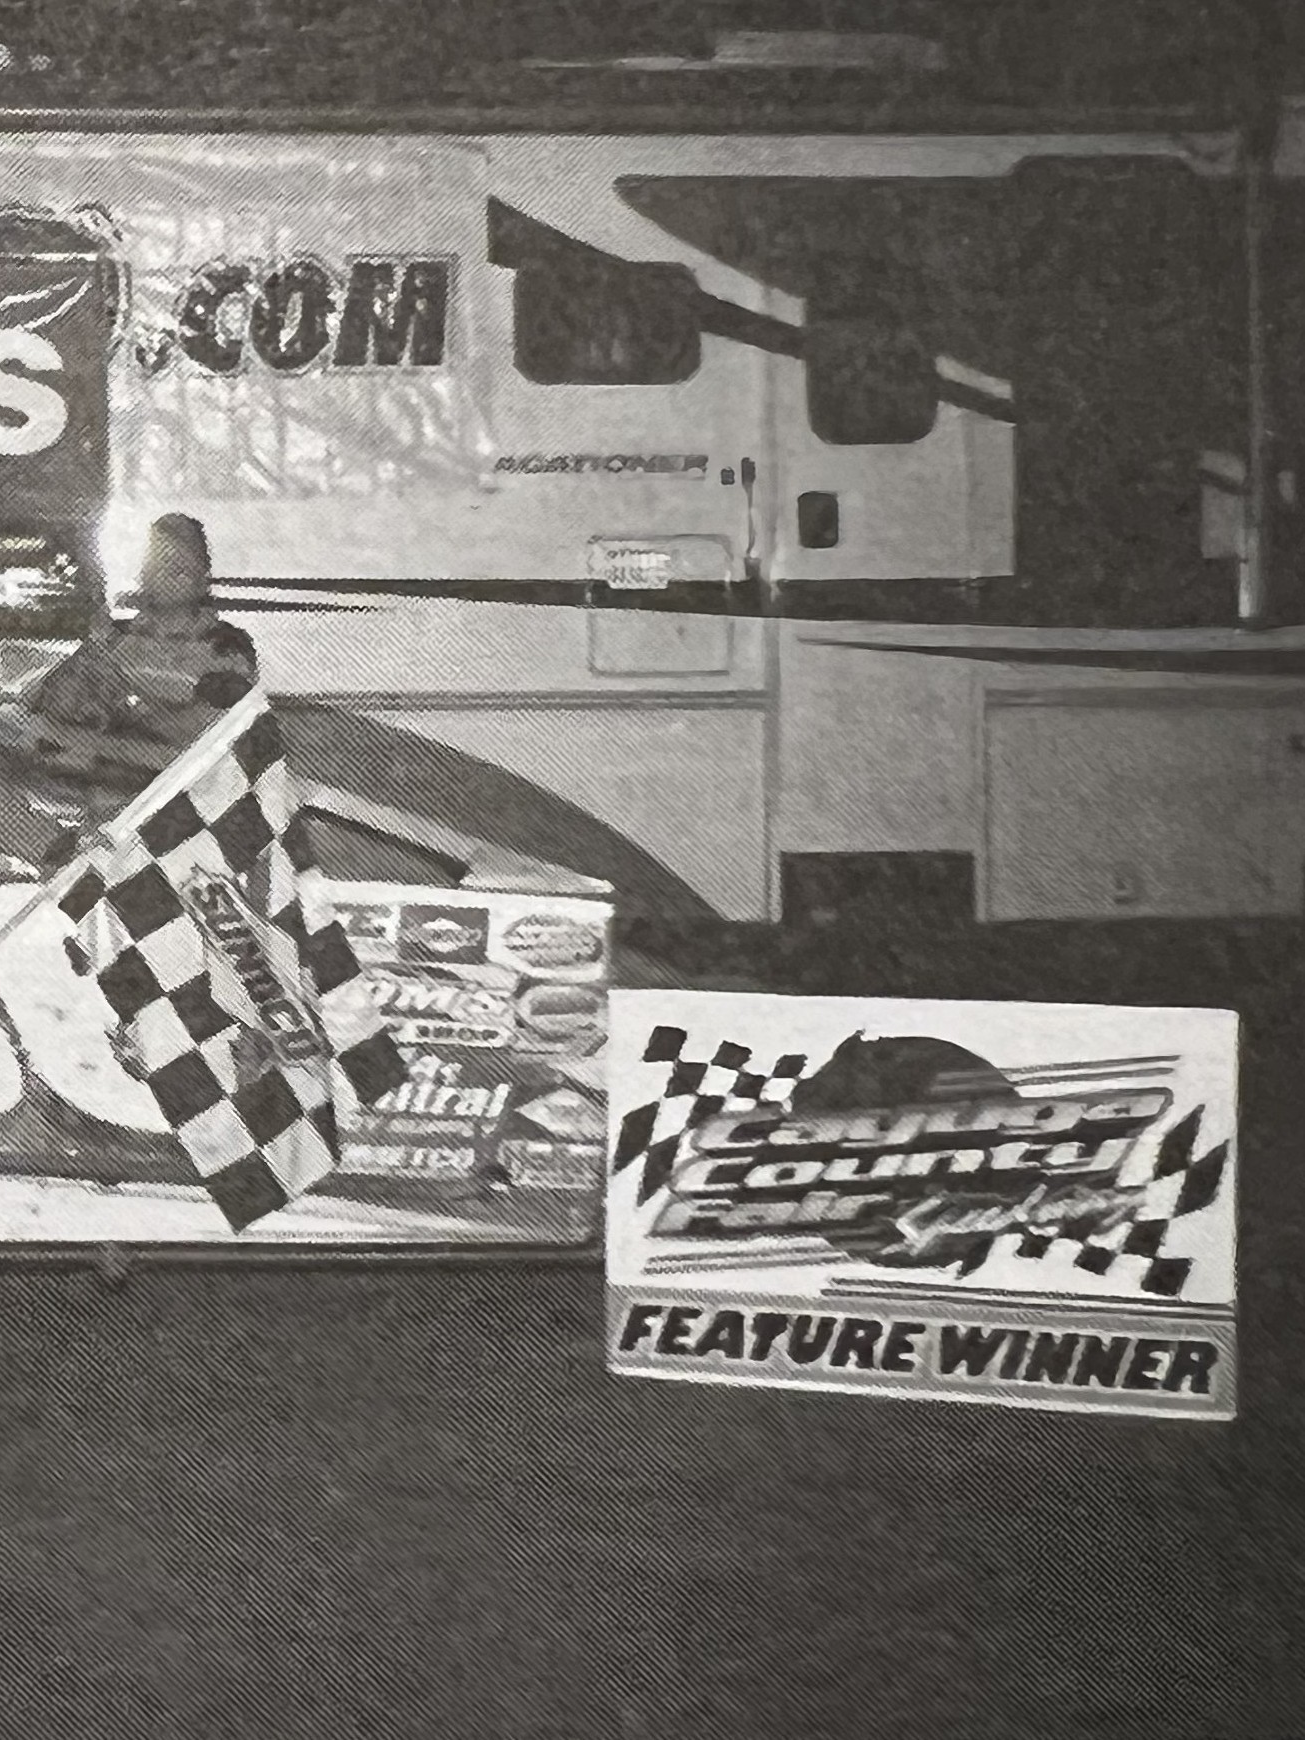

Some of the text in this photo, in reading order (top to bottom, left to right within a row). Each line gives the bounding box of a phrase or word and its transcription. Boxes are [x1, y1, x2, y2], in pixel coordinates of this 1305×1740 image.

[672, 1137, 1135, 1193] County
[618, 1303, 1220, 1394] FEATURE WINNER
